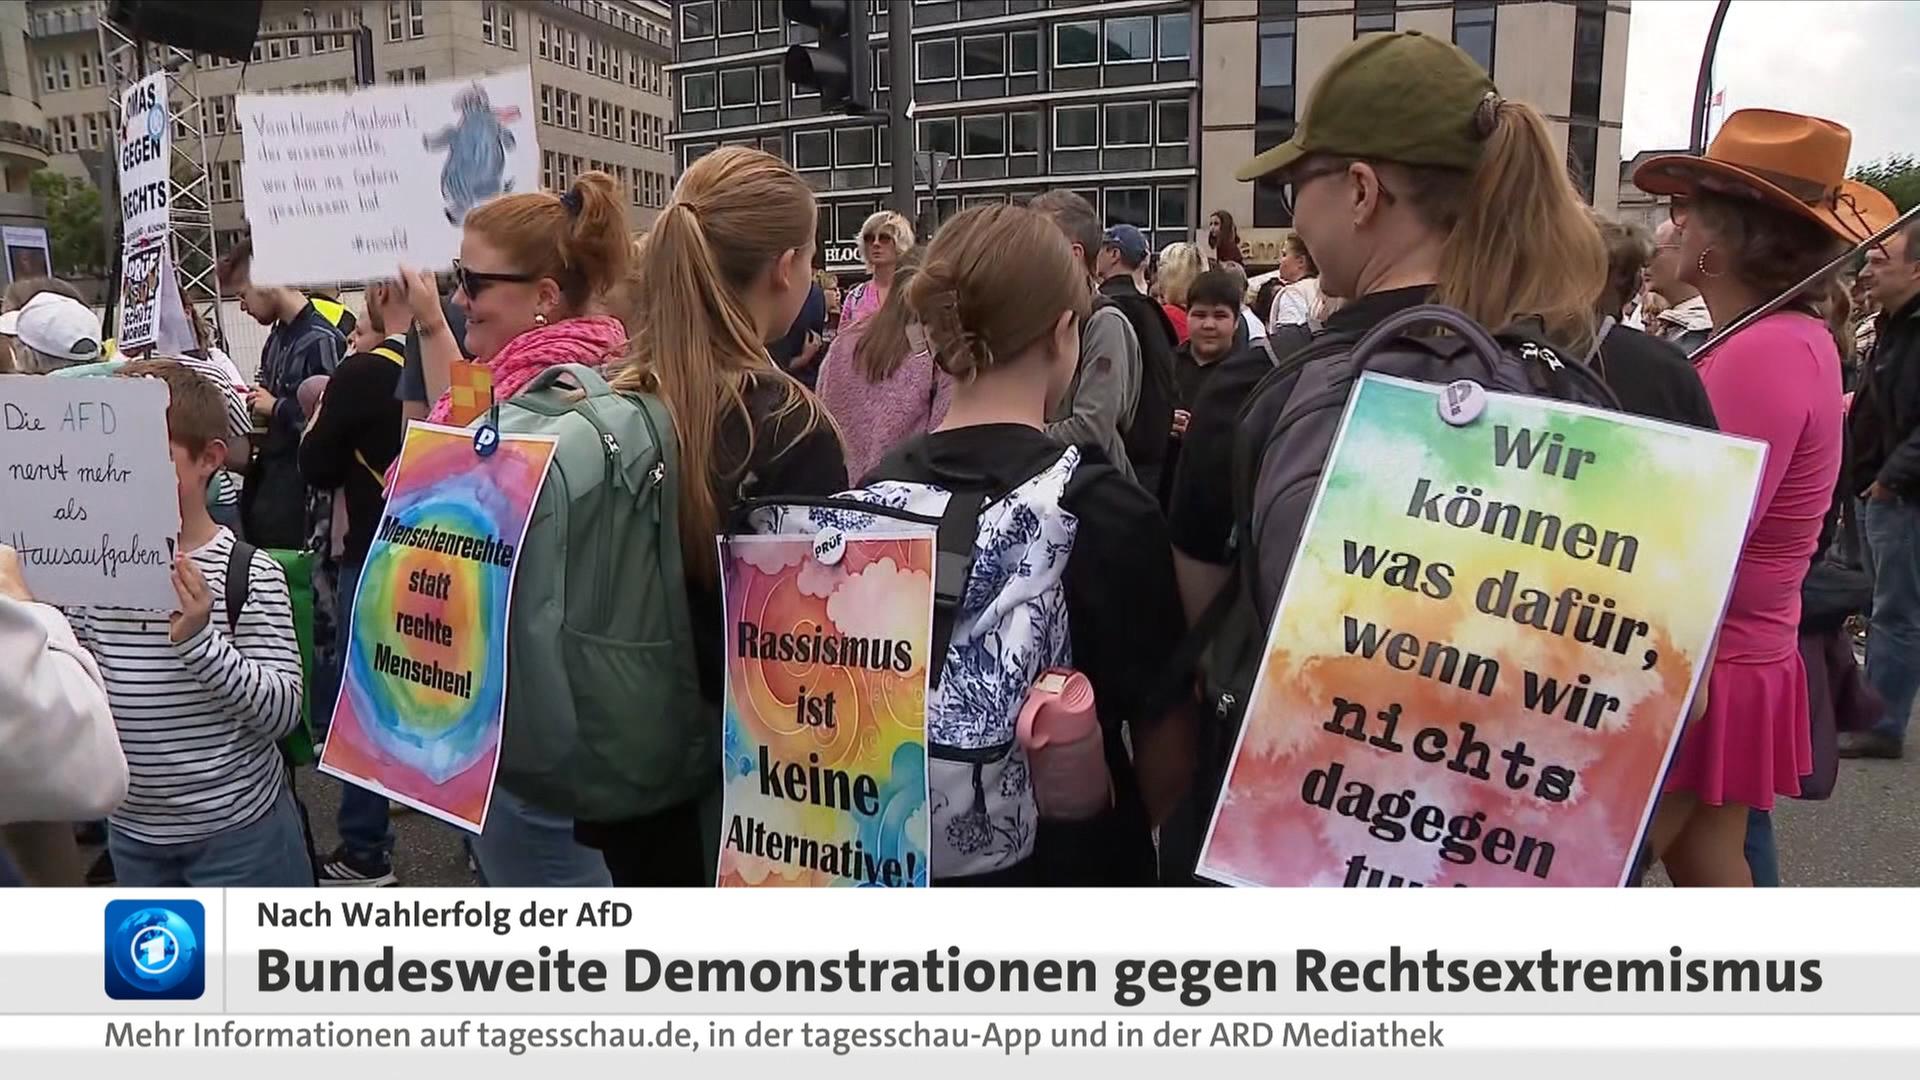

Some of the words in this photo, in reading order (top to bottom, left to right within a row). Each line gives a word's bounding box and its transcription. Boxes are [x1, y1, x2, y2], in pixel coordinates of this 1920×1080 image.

[122, 135, 161, 172] GEGEN
[123, 180, 167, 220] RECHTS
[127, 252, 159, 281] PRÜF
[825, 247, 862, 262] BLOC
[4, 402, 46, 431] Die
[59, 401, 118, 435] AFD
[8, 453, 69, 482] nervt
[77, 452, 134, 483] mehr
[1492, 423, 1596, 481] Wir
[53, 497, 88, 521] als
[1405, 477, 1640, 573] können
[377, 514, 515, 568] Menschenrechte
[813, 532, 844, 560] PRÜF
[407, 567, 452, 601] statt
[1342, 538, 1456, 600] was
[1475, 568, 1660, 671] dafür,
[395, 611, 453, 647] rechte
[736, 620, 913, 673] Rassismus
[373, 642, 473, 700] Menschen!
[1342, 614, 1500, 697] wenn
[1522, 668, 1621, 731] wir
[796, 685, 837, 730] ist
[1322, 695, 1577, 803] nichts
[758, 743, 881, 818] keine
[1300, 761, 1556, 880] dagegen
[725, 814, 917, 888] Alternative!
